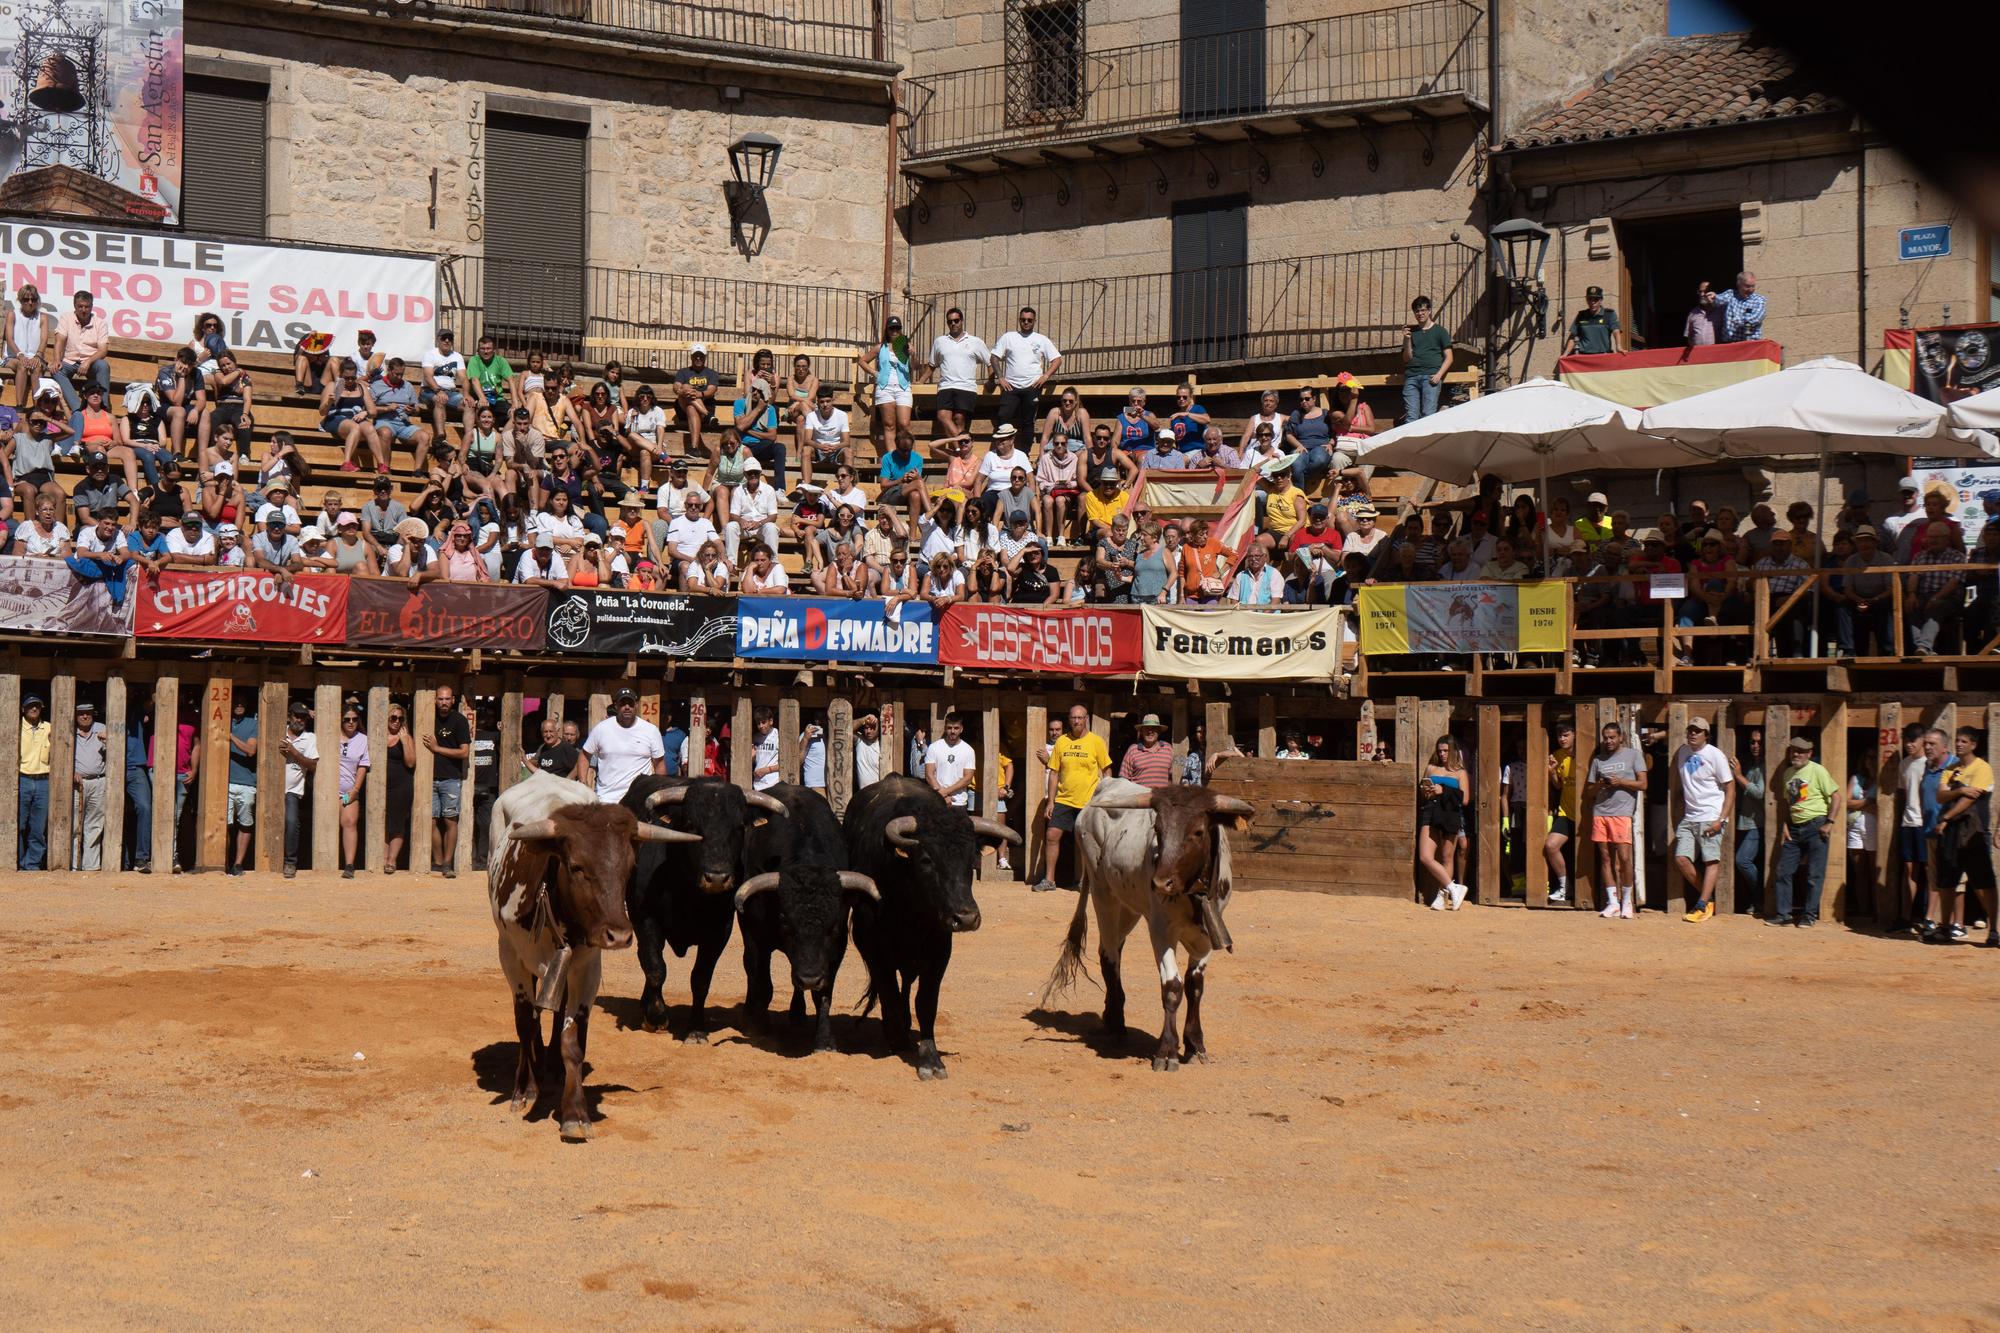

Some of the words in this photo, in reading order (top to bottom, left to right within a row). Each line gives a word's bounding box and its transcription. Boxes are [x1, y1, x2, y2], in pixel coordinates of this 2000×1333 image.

[140, 30, 170, 120] Agustín
[138, 124, 162, 167] San
[466, 100, 482, 242] JUZGADO
[1913, 233, 1937, 241] PLAZA
[0, 262, 162, 303] NTRO
[184, 277, 249, 310] DE
[268, 285, 434, 323] SALUD
[153, 575, 331, 618] CHIPIRONES
[596, 595, 619, 608] Peña
[360, 610, 394, 635] EL
[400, 590, 534, 640] QUIEBRO
[1371, 610, 1397, 618] DESDE
[1529, 607, 1557, 616] DESDE
[1375, 621, 1396, 629] 1970
[1532, 618, 1554, 627] 1970
[741, 609, 799, 649] PEÑA
[804, 607, 933, 655] DESMADRE
[976, 612, 1113, 666] DESFASADOS
[211, 687, 230, 701] 23
[212, 706, 223, 721] A
[642, 702, 658, 716] 25
[692, 703, 704, 716] 26
